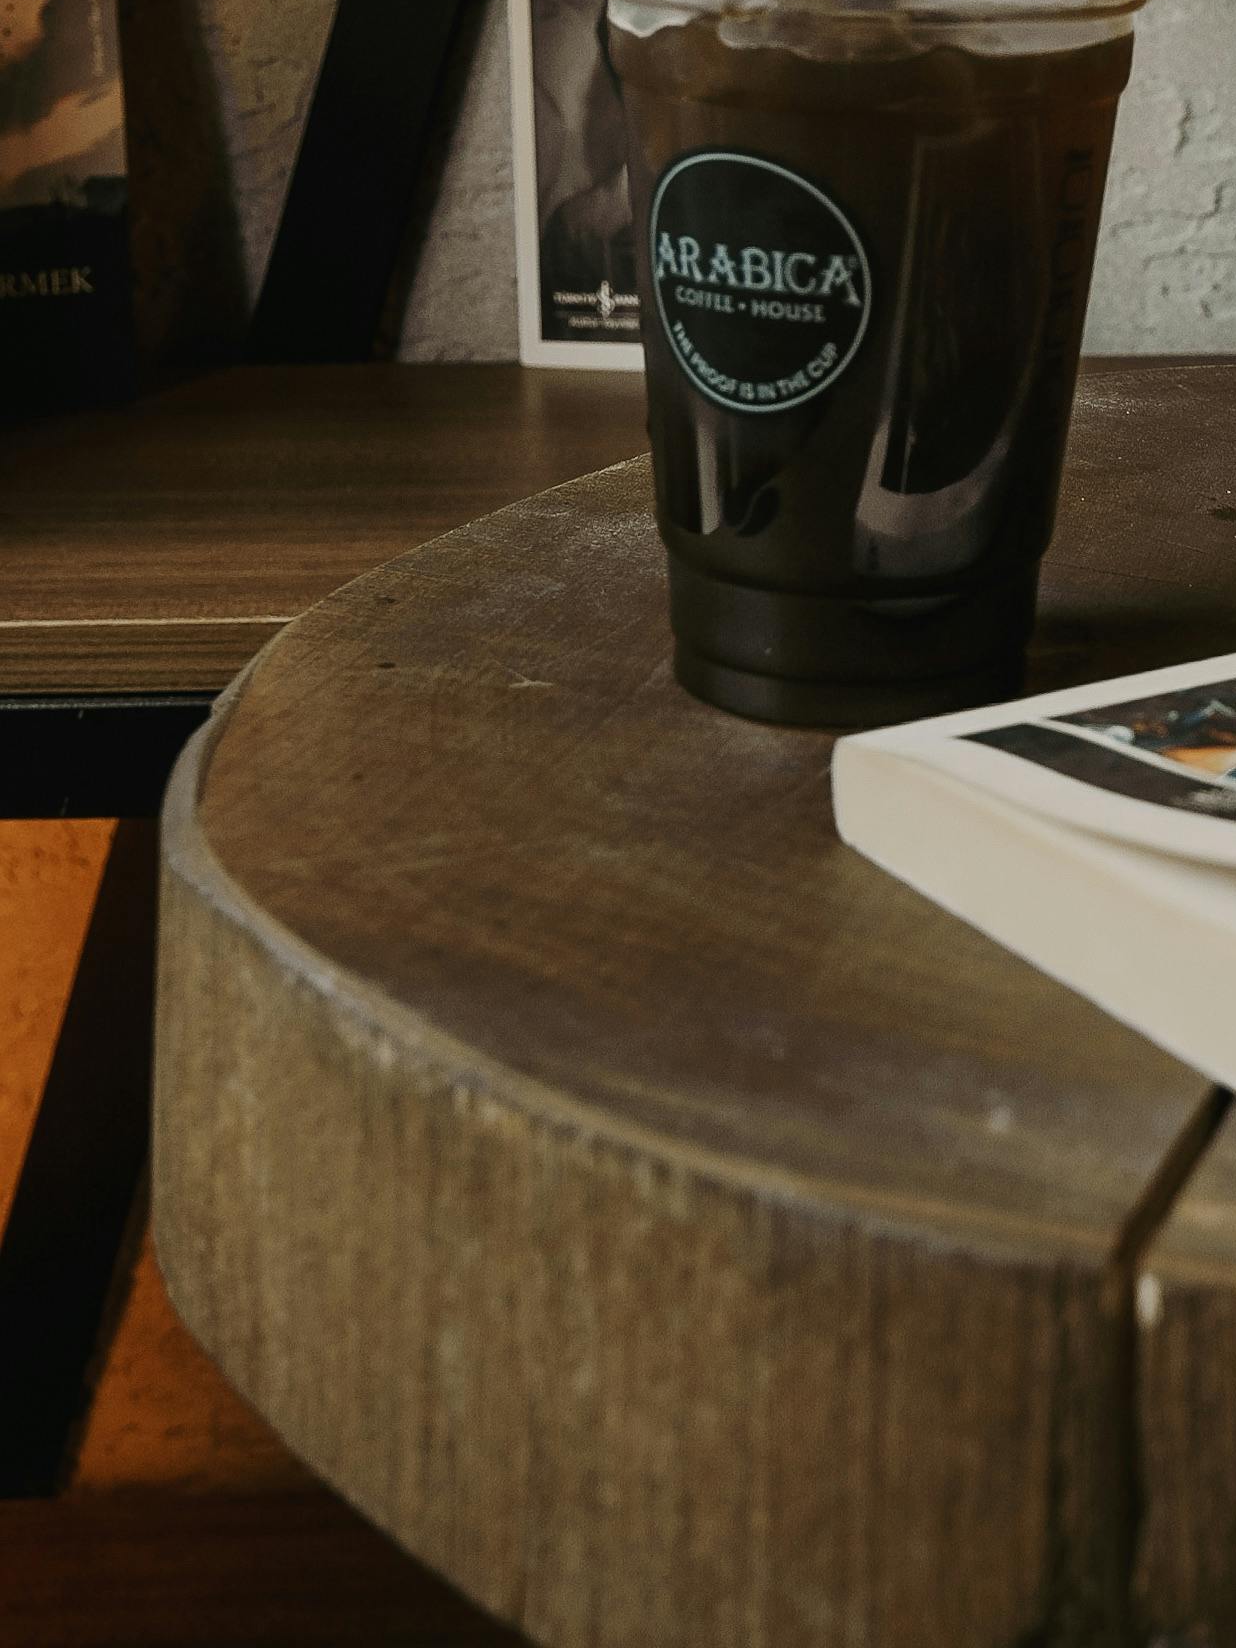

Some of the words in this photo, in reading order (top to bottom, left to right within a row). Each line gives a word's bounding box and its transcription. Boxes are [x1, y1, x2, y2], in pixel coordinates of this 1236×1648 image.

[655, 232, 862, 308] ARABICA
[751, 300, 827, 322] HOUSE
[806, 342, 838, 378] CUP
